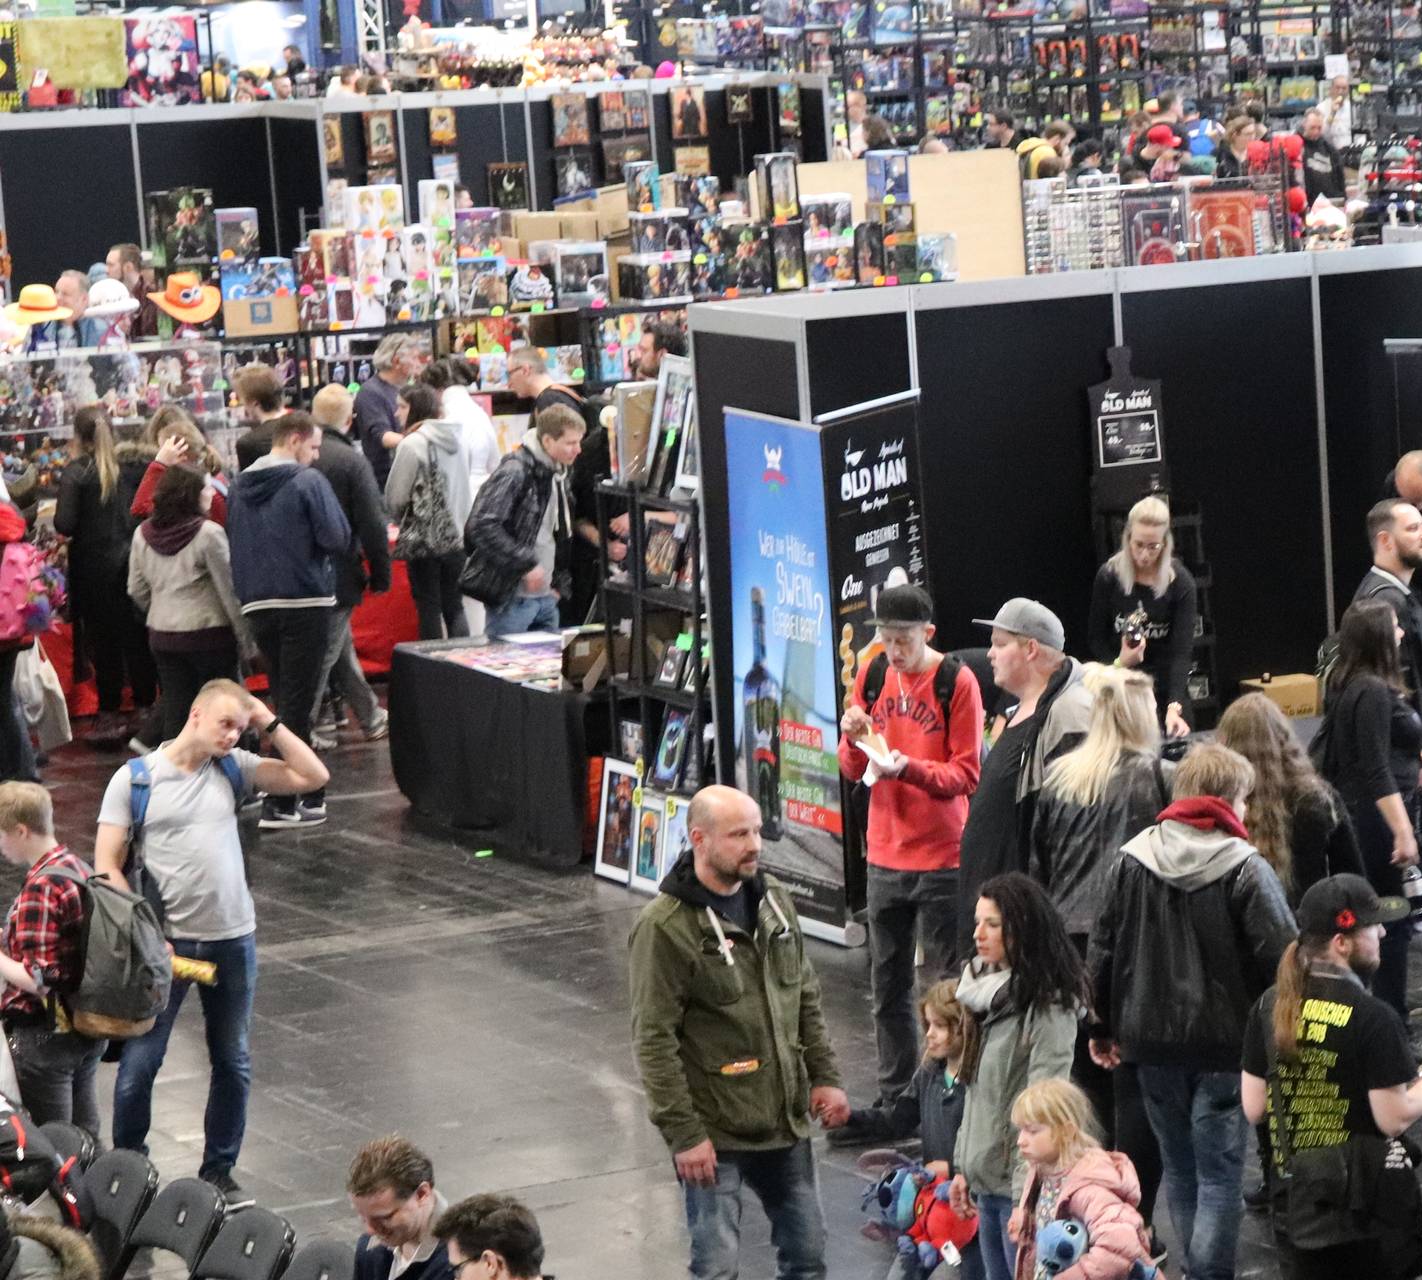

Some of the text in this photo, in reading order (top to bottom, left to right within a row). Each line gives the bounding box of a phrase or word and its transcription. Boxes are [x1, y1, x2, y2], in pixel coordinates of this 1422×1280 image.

[1126, 395, 1152, 410] MAN
[840, 456, 908, 502] OLD MAN
[841, 574, 864, 601] One
[872, 695, 945, 736] SUPERDRY
